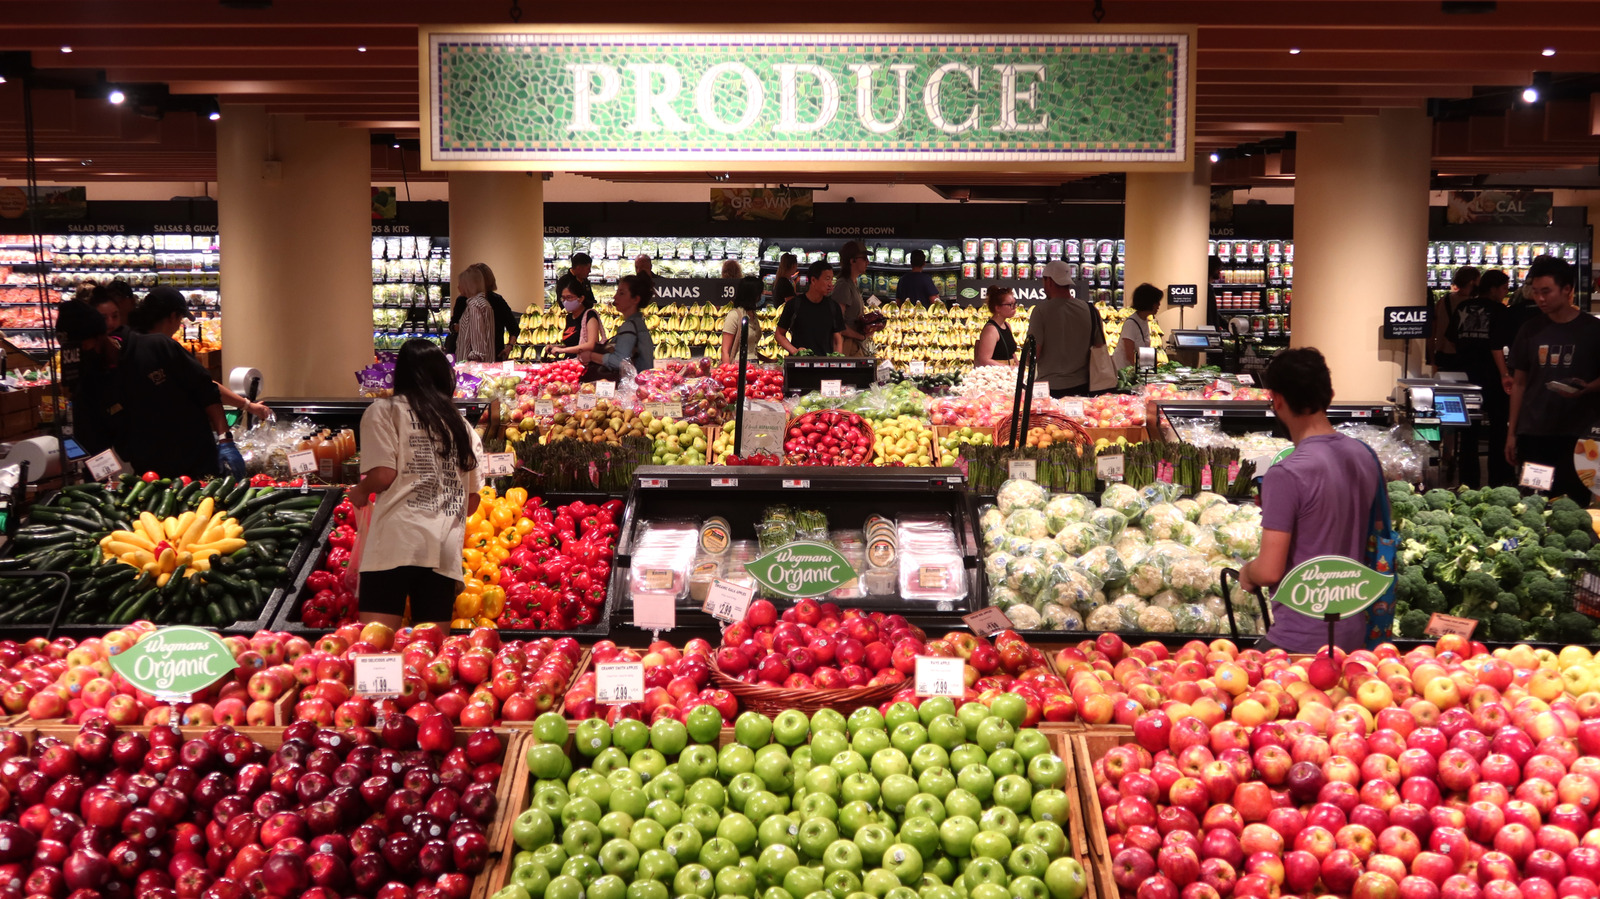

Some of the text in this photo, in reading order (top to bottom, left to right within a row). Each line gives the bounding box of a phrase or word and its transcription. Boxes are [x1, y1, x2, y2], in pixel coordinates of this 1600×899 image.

[565, 60, 1049, 134] PRODUCE
[68, 224, 125, 232] SALAD BOWLS
[154, 224, 183, 232] SALSAS
[185, 224, 192, 232] &
[392, 225, 410, 233] KITS
[826, 226, 895, 235] INDOOR GROWN
[653, 285, 736, 298] NANAS .59
[980, 286, 1047, 298] BANAS
[1170, 287, 1195, 295] SCALE
[1389, 311, 1427, 323] SCALE
[774, 549, 832, 565] Wegmans
[767, 564, 840, 592] Organic
[1300, 564, 1362, 587] Wegmans
[1291, 580, 1370, 613] Organic
[143, 636, 209, 659] Wegmans
[134, 653, 218, 689] Organic
